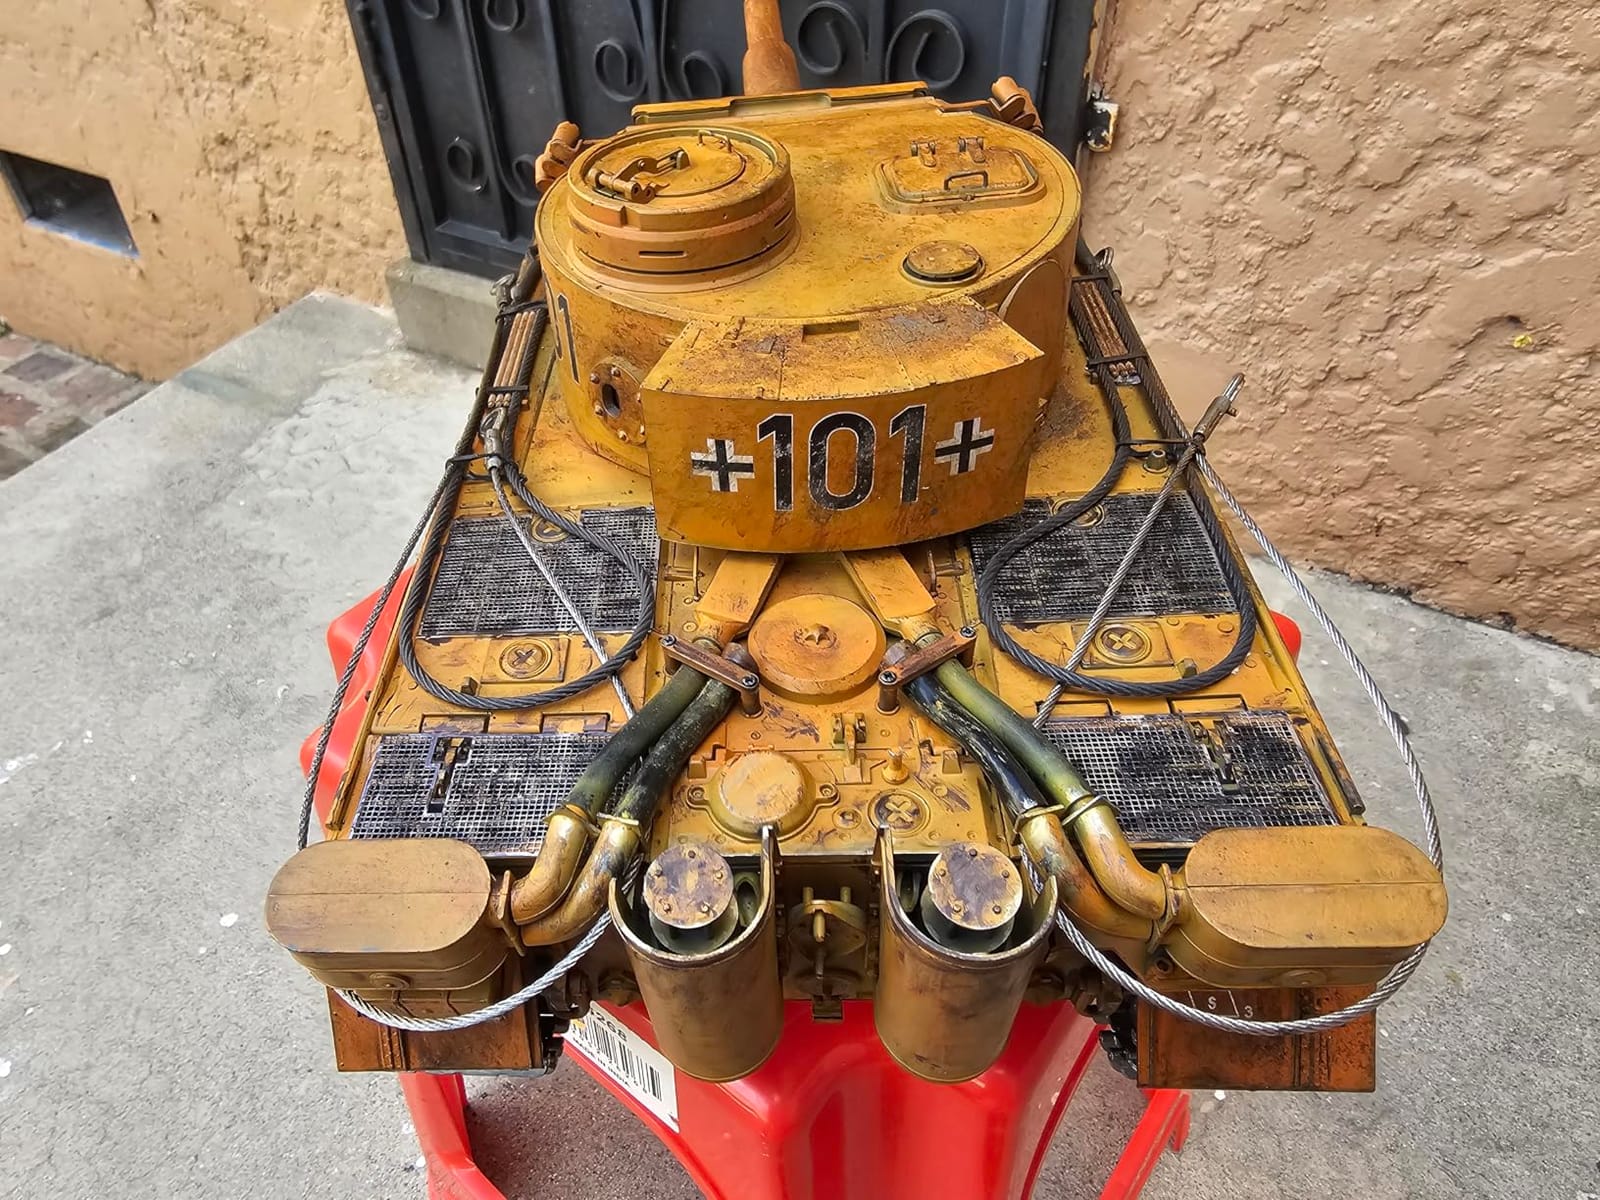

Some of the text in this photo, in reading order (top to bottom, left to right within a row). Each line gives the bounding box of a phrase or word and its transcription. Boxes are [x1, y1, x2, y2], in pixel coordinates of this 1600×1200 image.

[756, 404, 927, 511] 101
[1207, 995, 1217, 1011] S
[1244, 1004, 1254, 1018] 3
